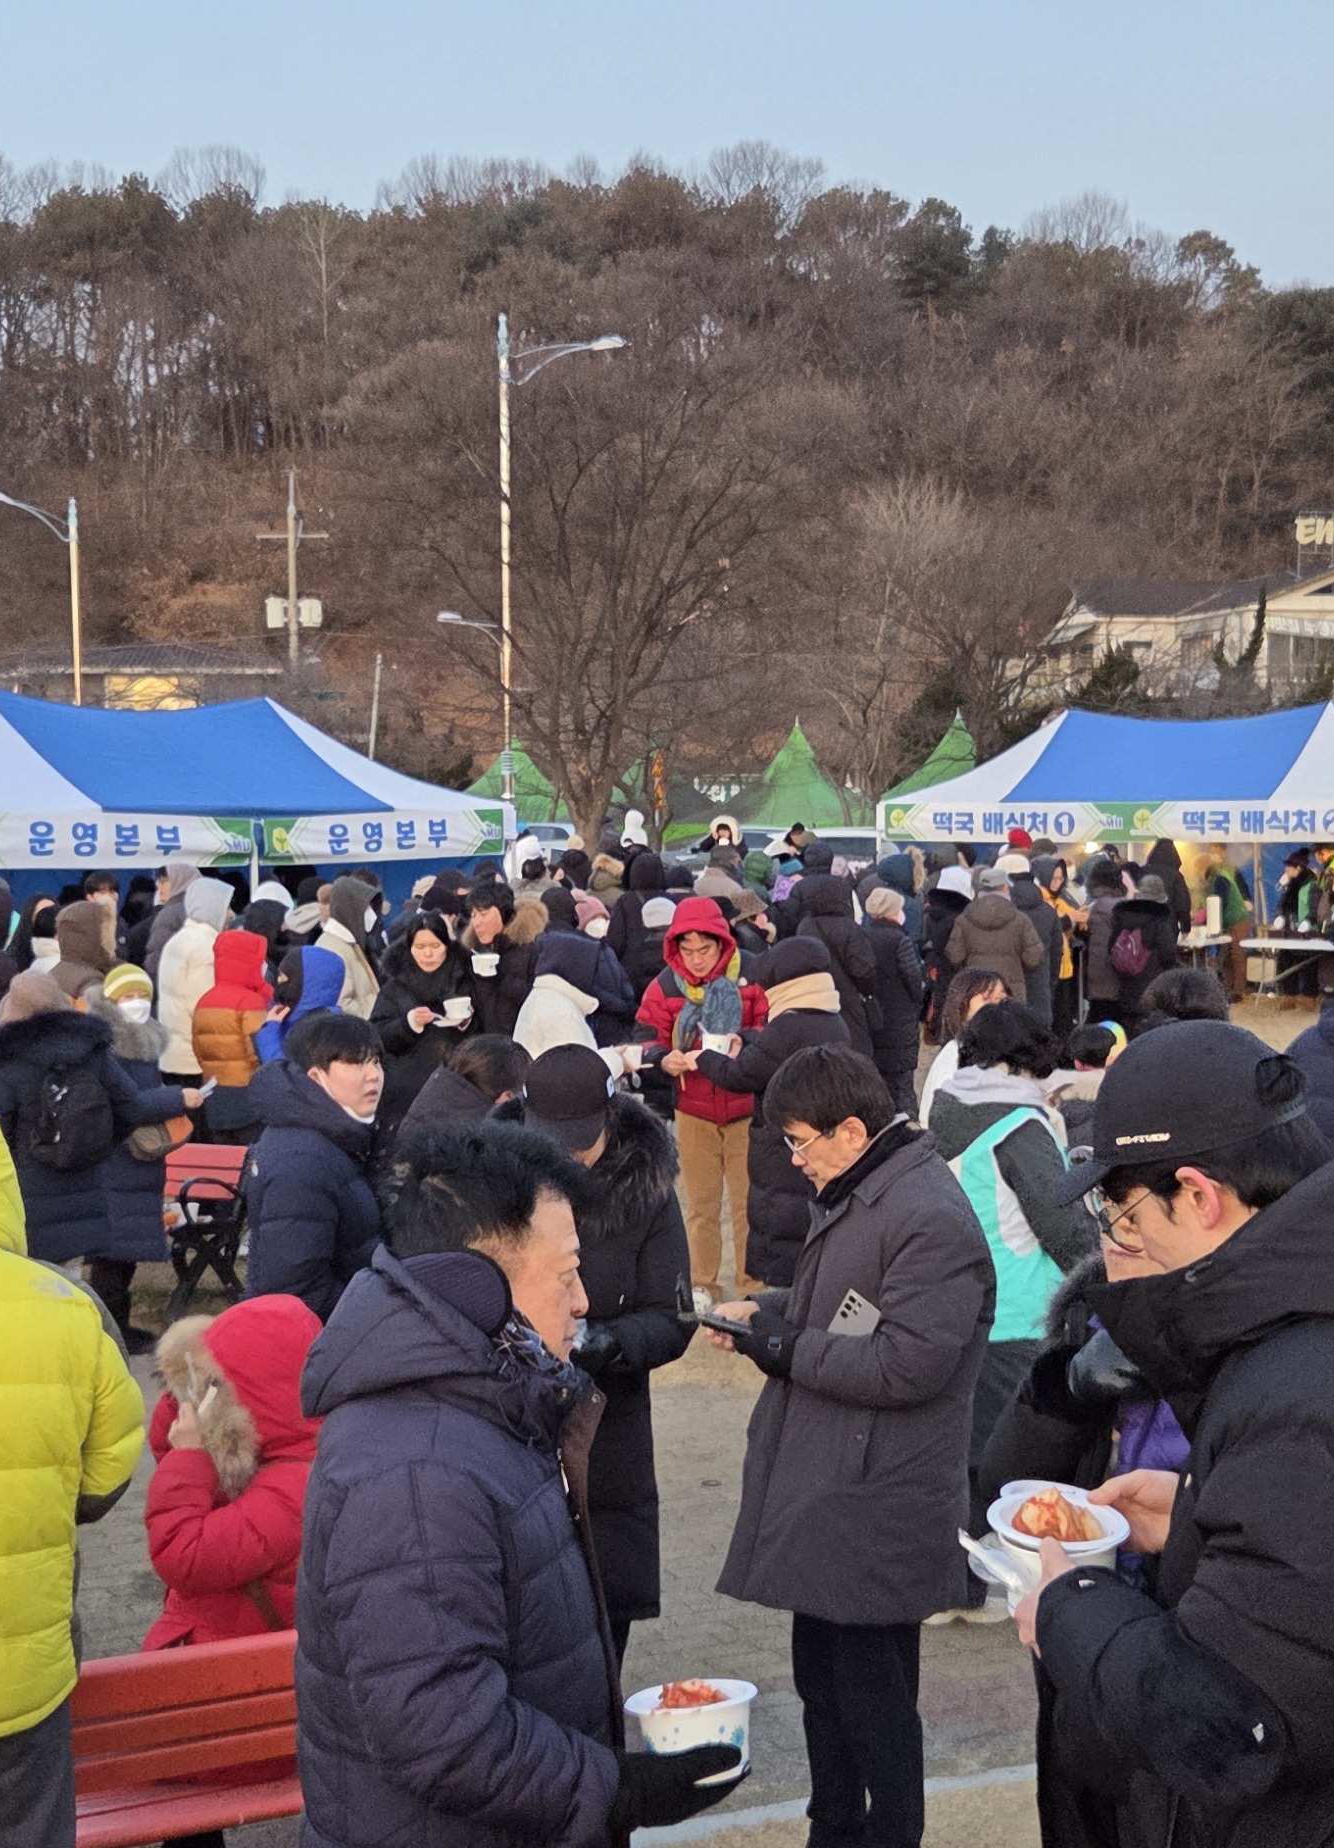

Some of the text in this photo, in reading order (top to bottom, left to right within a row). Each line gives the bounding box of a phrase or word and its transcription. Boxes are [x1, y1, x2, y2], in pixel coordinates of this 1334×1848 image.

[28, 820, 183, 857] 운영본부
[327, 818, 448, 856] 운영본부
[932, 811, 975, 835] 떡국
[982, 811, 1049, 836] 배식처
[1182, 810, 1231, 836] 떡국
[1240, 809, 1317, 835] 배식처
